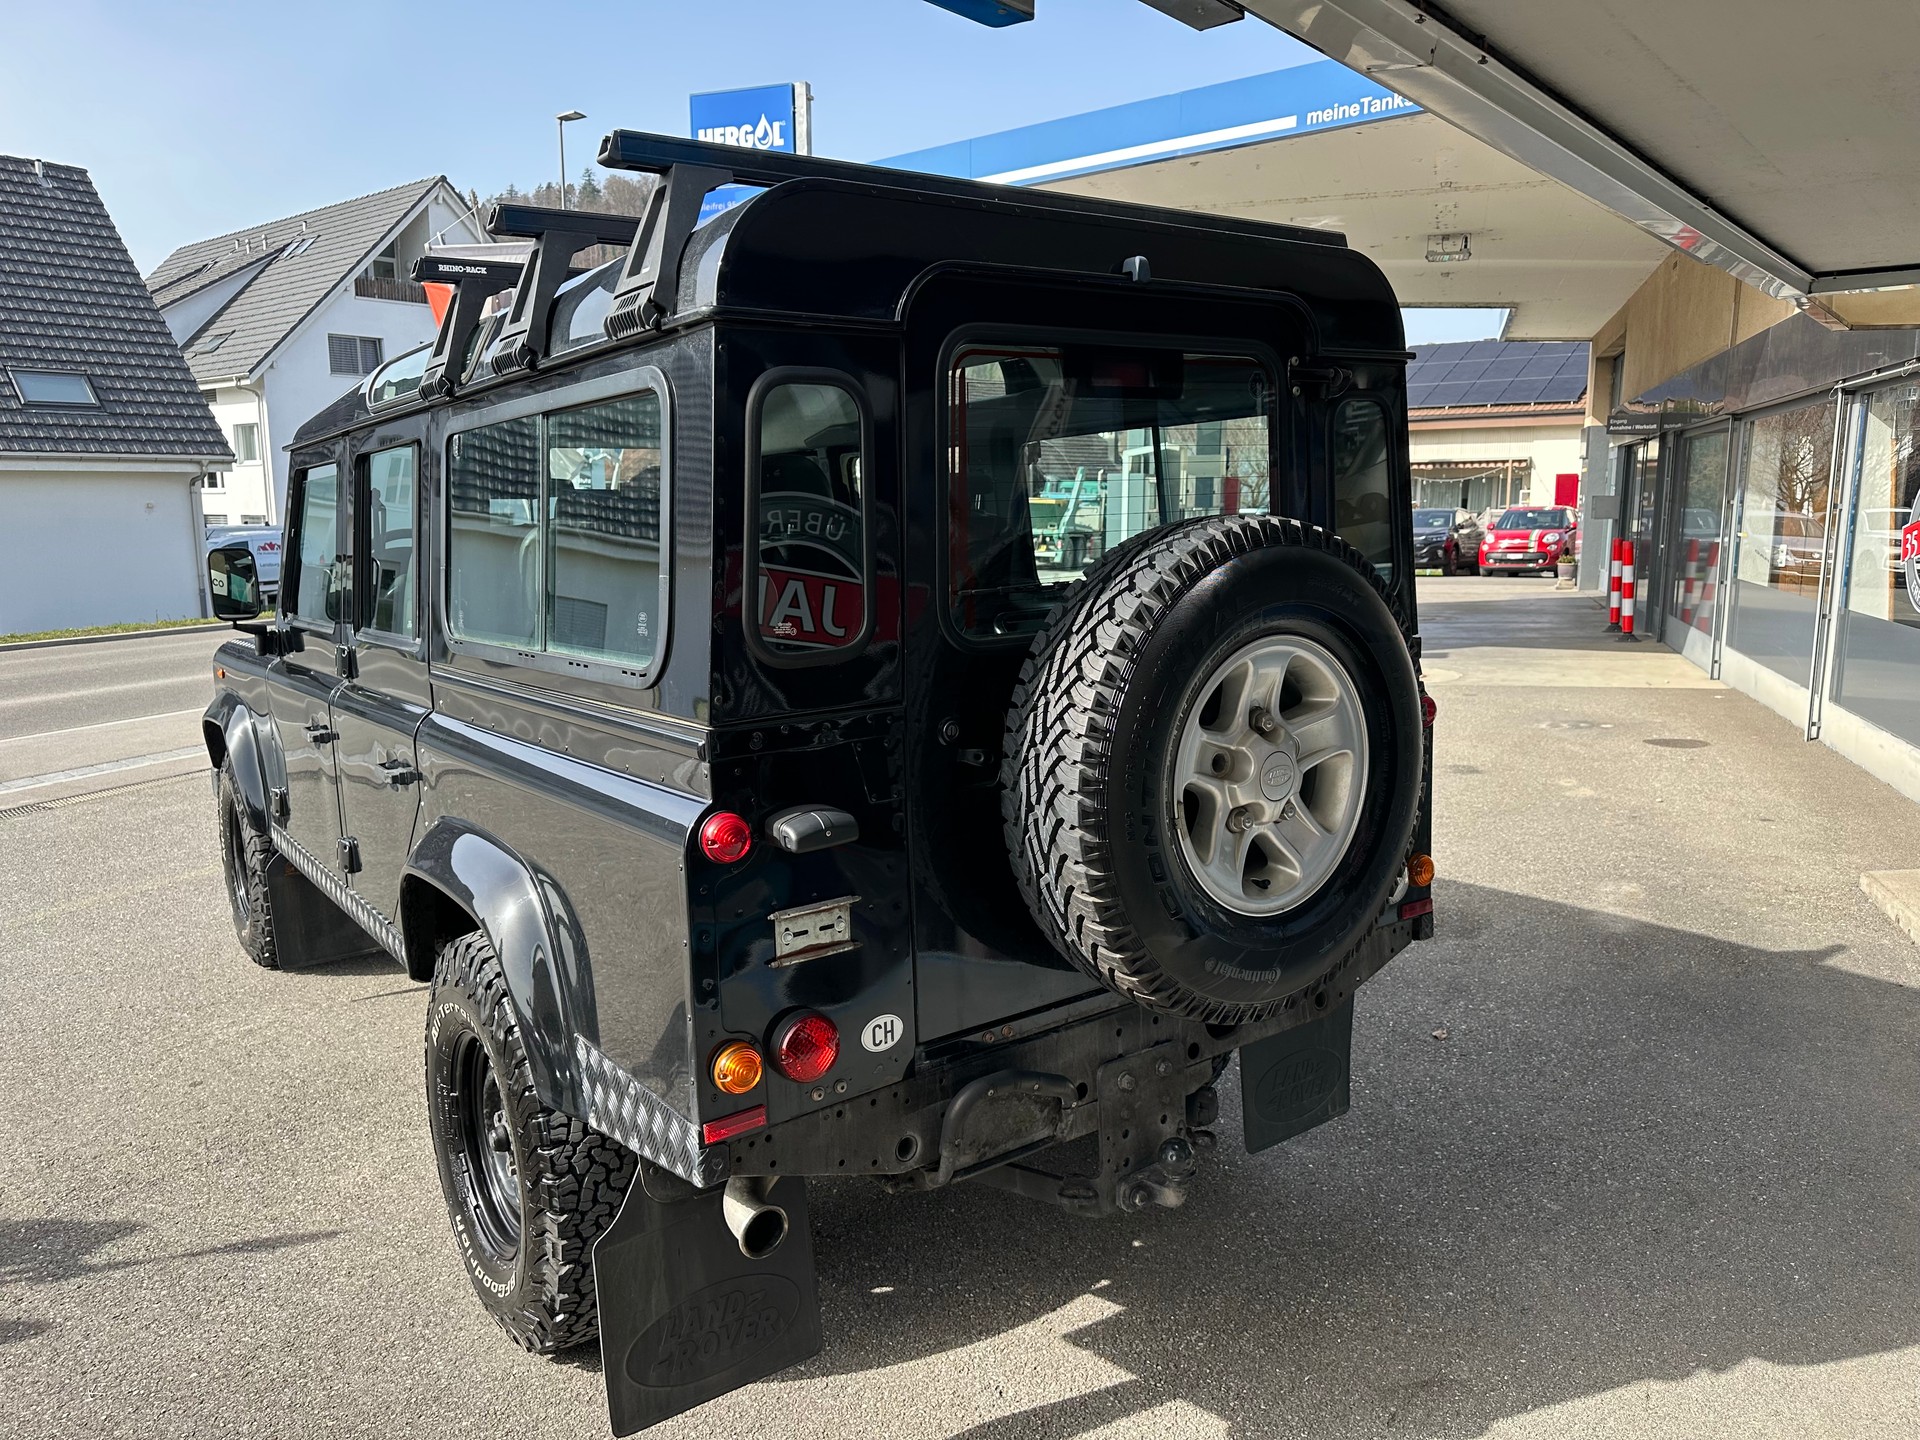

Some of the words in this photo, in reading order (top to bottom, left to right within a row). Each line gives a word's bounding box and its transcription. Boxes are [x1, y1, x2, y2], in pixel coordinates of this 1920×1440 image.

[437, 264, 488, 274] RHINO-RACK
[1213, 960, 1282, 985] Continental
[871, 1018, 895, 1047] CH
[660, 1288, 748, 1348] LAND
[671, 1305, 781, 1374] ROVER
